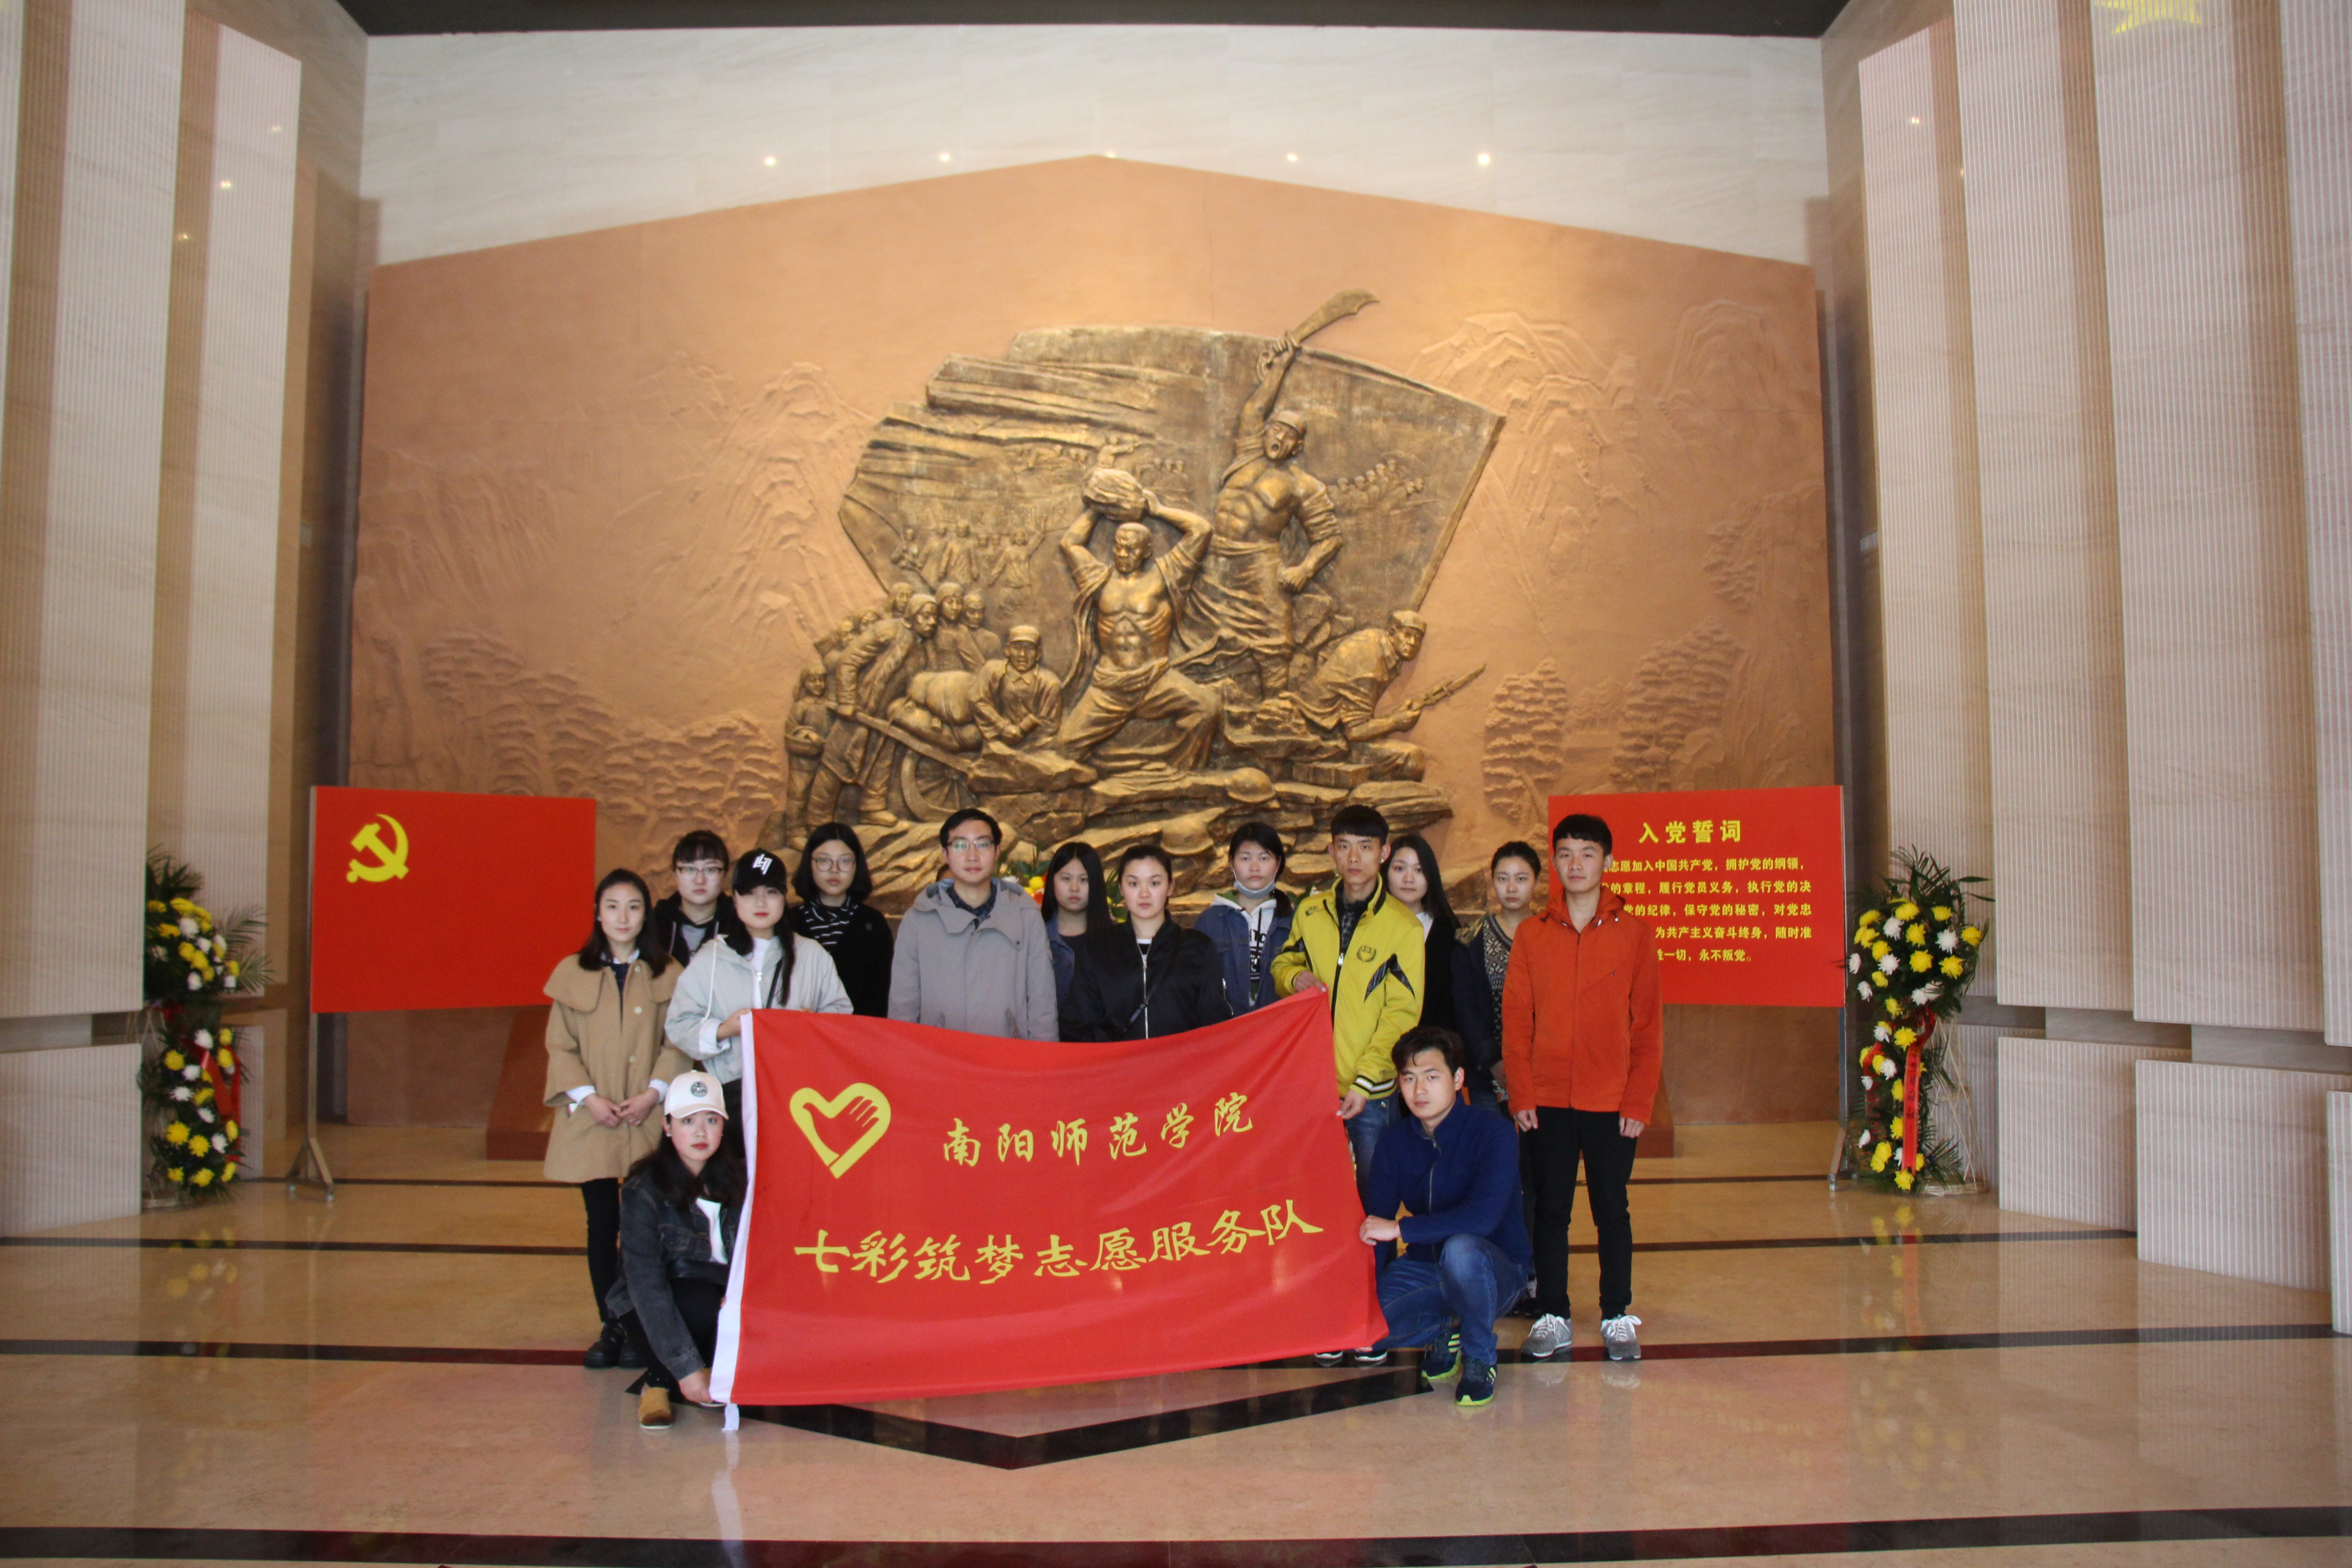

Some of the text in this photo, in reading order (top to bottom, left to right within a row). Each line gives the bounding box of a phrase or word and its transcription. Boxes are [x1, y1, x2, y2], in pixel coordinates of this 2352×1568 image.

[1638, 819, 1741, 844] 入党誓词
[1603, 857, 1804, 872] 志愿加入中国共产党，拥护党的纲领，
[1655, 926, 1812, 939] 为共产主义奋斗终身，随时准
[943, 1091, 1254, 1167] 南阳师范学院
[794, 1199, 1324, 1285] 七彩筑梦志愿服务队
